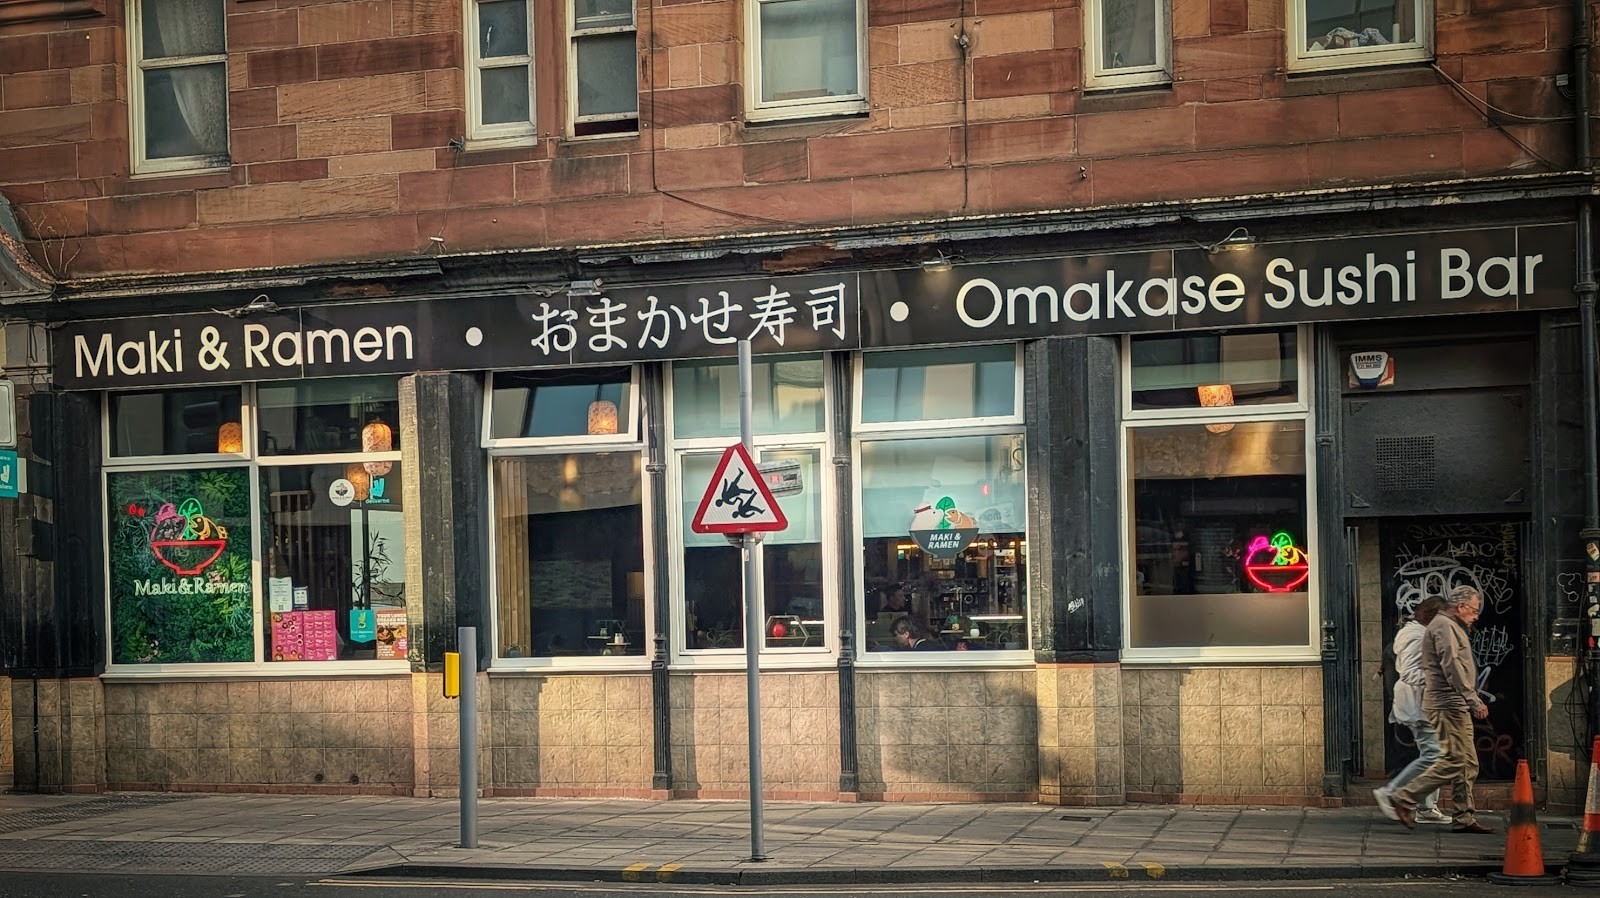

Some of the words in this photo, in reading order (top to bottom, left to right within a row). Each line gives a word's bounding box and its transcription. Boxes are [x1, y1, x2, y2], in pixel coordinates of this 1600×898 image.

[956, 270, 1246, 328] Omakase
[1265, 251, 1415, 308] Sushi
[1441, 249, 1542, 298] Bar
[531, 282, 846, 356] おまかせ寿司
[75, 329, 182, 377] Maki
[199, 326, 230, 370] &
[244, 324, 414, 368] Ramen
[927, 541, 959, 549] RAMEN
[929, 533, 953, 541] MAKI
[954, 532, 961, 541] &
